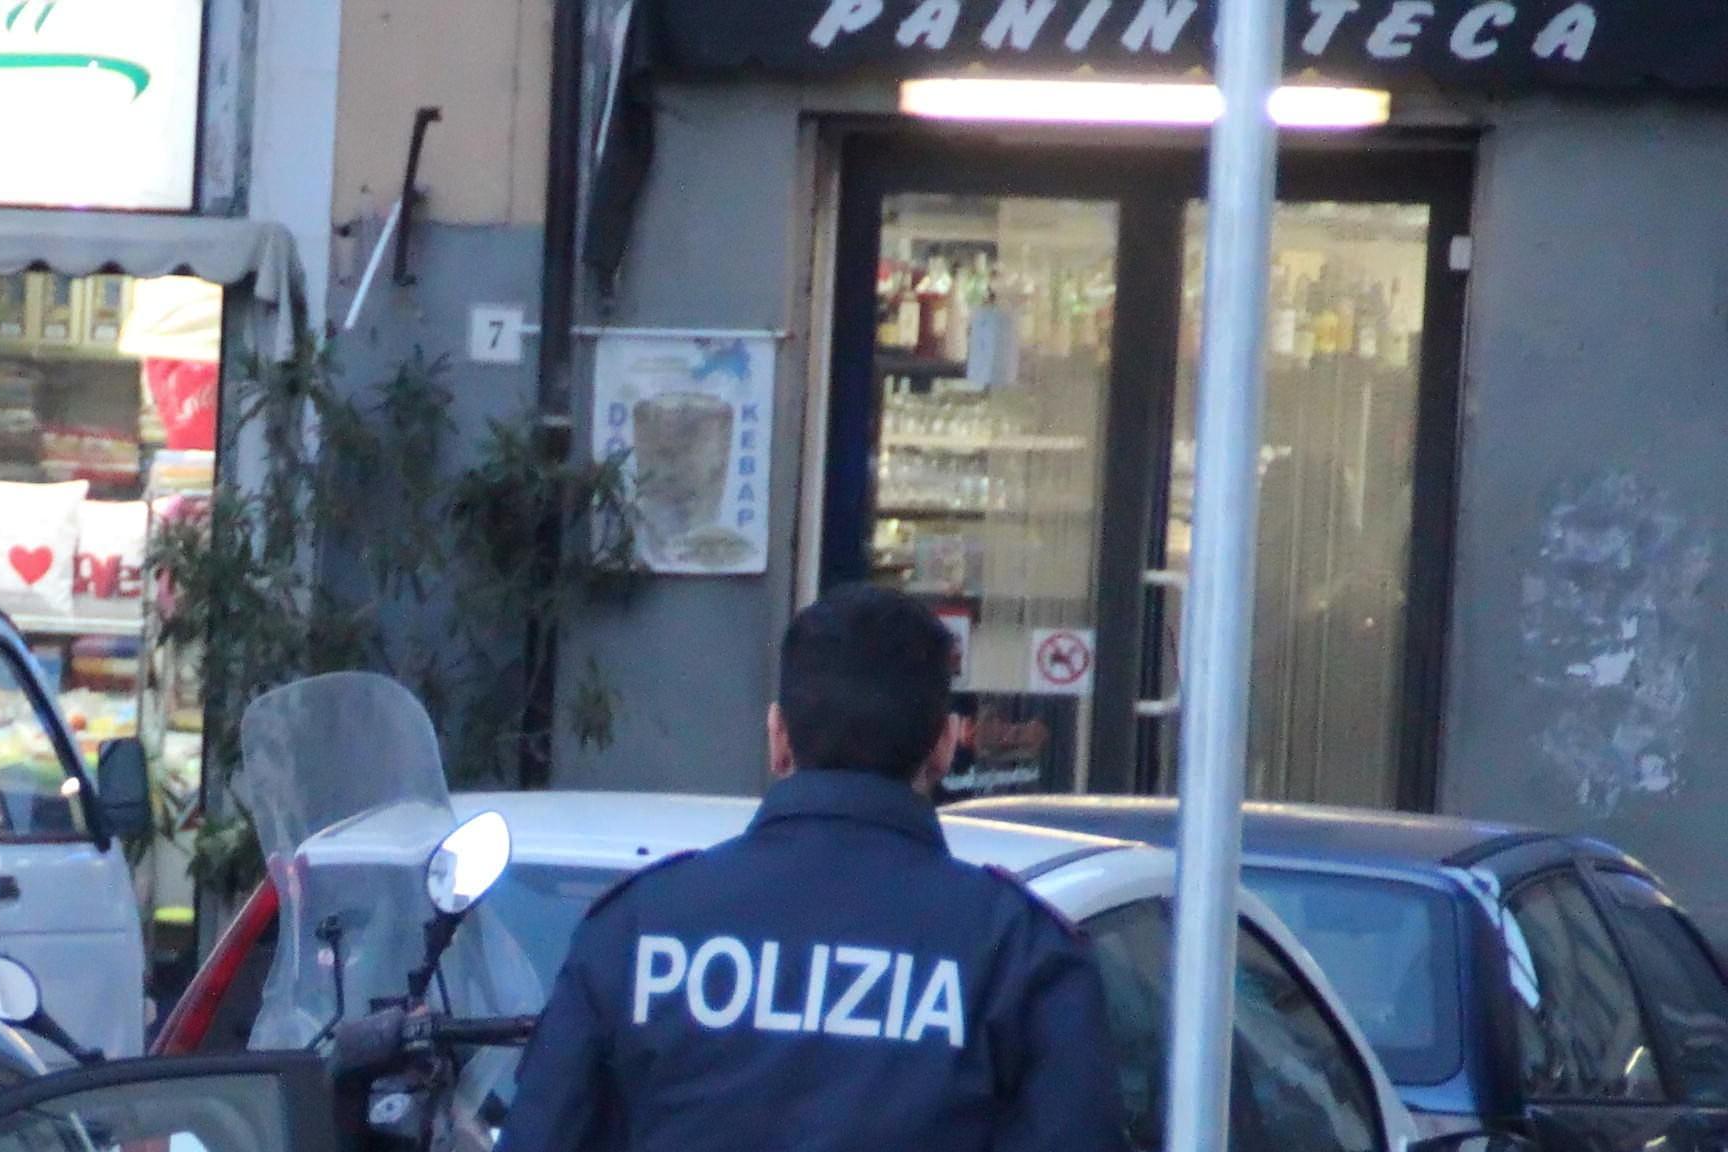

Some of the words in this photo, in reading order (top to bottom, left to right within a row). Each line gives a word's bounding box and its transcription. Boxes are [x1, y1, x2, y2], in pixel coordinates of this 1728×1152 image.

[807, 0, 1599, 61] PANINTECA
[489, 320, 505, 349] 7
[737, 404, 760, 527] KEBAP
[633, 934, 965, 1049] POLIZIA
